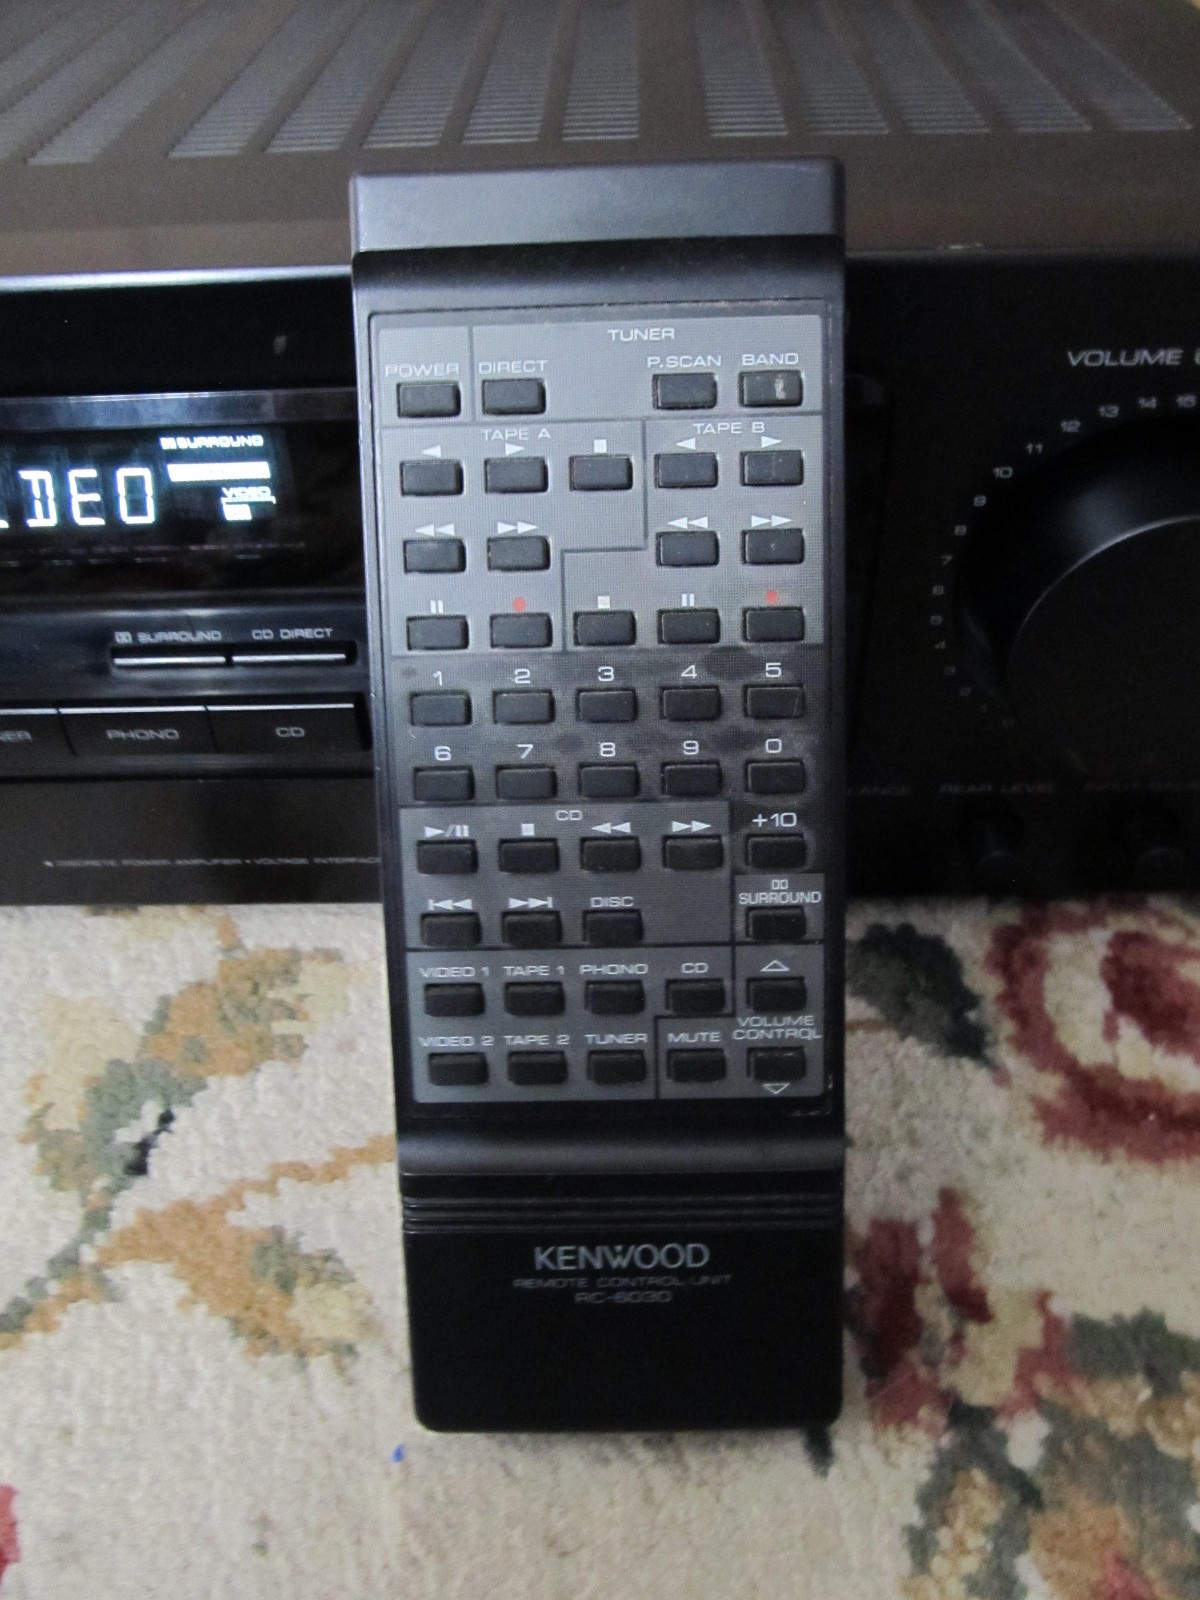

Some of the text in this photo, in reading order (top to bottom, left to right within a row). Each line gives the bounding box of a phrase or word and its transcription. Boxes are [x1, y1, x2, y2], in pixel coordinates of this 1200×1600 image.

[607, 328, 675, 341] TUNER
[647, 355, 722, 369] P.SCAN
[741, 353, 799, 366] BAND
[1067, 348, 1184, 367] VOLUME
[385, 362, 460, 377] POWER
[478, 360, 548, 374] DIRECT
[1137, 396, 1158, 409] 14
[1099, 404, 1120, 418] 13
[693, 421, 766, 435] TAPE B
[1060, 419, 1082, 433] 12
[177, 434, 264, 449] SURROUND
[482, 428, 551, 441] TAPE A
[1026, 442, 1043, 454] 11
[993, 466, 1013, 479] 10
[137, 630, 223, 644] SURROUND
[252, 627, 334, 640] CD DIRECT
[514, 669, 531, 684] 2
[598, 666, 615, 682] 3
[681, 665, 698, 679] 4
[765, 663, 782, 678] 5
[434, 671, 442, 686] 1
[106, 728, 180, 741] PHONO
[275, 726, 305, 738] CD
[517, 744, 534, 758] 7
[599, 742, 616, 757] 8
[683, 740, 700, 755] 9
[765, 739, 783, 753] 0
[434, 746, 451, 761] 6
[556, 809, 583, 822] CD
[751, 812, 798, 828] +10
[591, 896, 634, 908] DISC
[739, 891, 822, 905] SURROUND
[420, 965, 491, 978] VIDEO 1
[503, 964, 565, 977] TAPE 1
[580, 962, 648, 975] PHONO
[681, 961, 709, 974] CD
[737, 1015, 815, 1028] VOLUME
[419, 1034, 495, 1048] VIDEO 2
[503, 1033, 570, 1046] TAPE 2
[585, 1032, 648, 1045] TUNER
[667, 1031, 722, 1044] MUTE
[732, 1027, 822, 1041] CONTROL
[534, 1243, 711, 1272] KENWOOD
[512, 1278, 589, 1290] REMOTE
[596, 1275, 682, 1289] CONTROL
